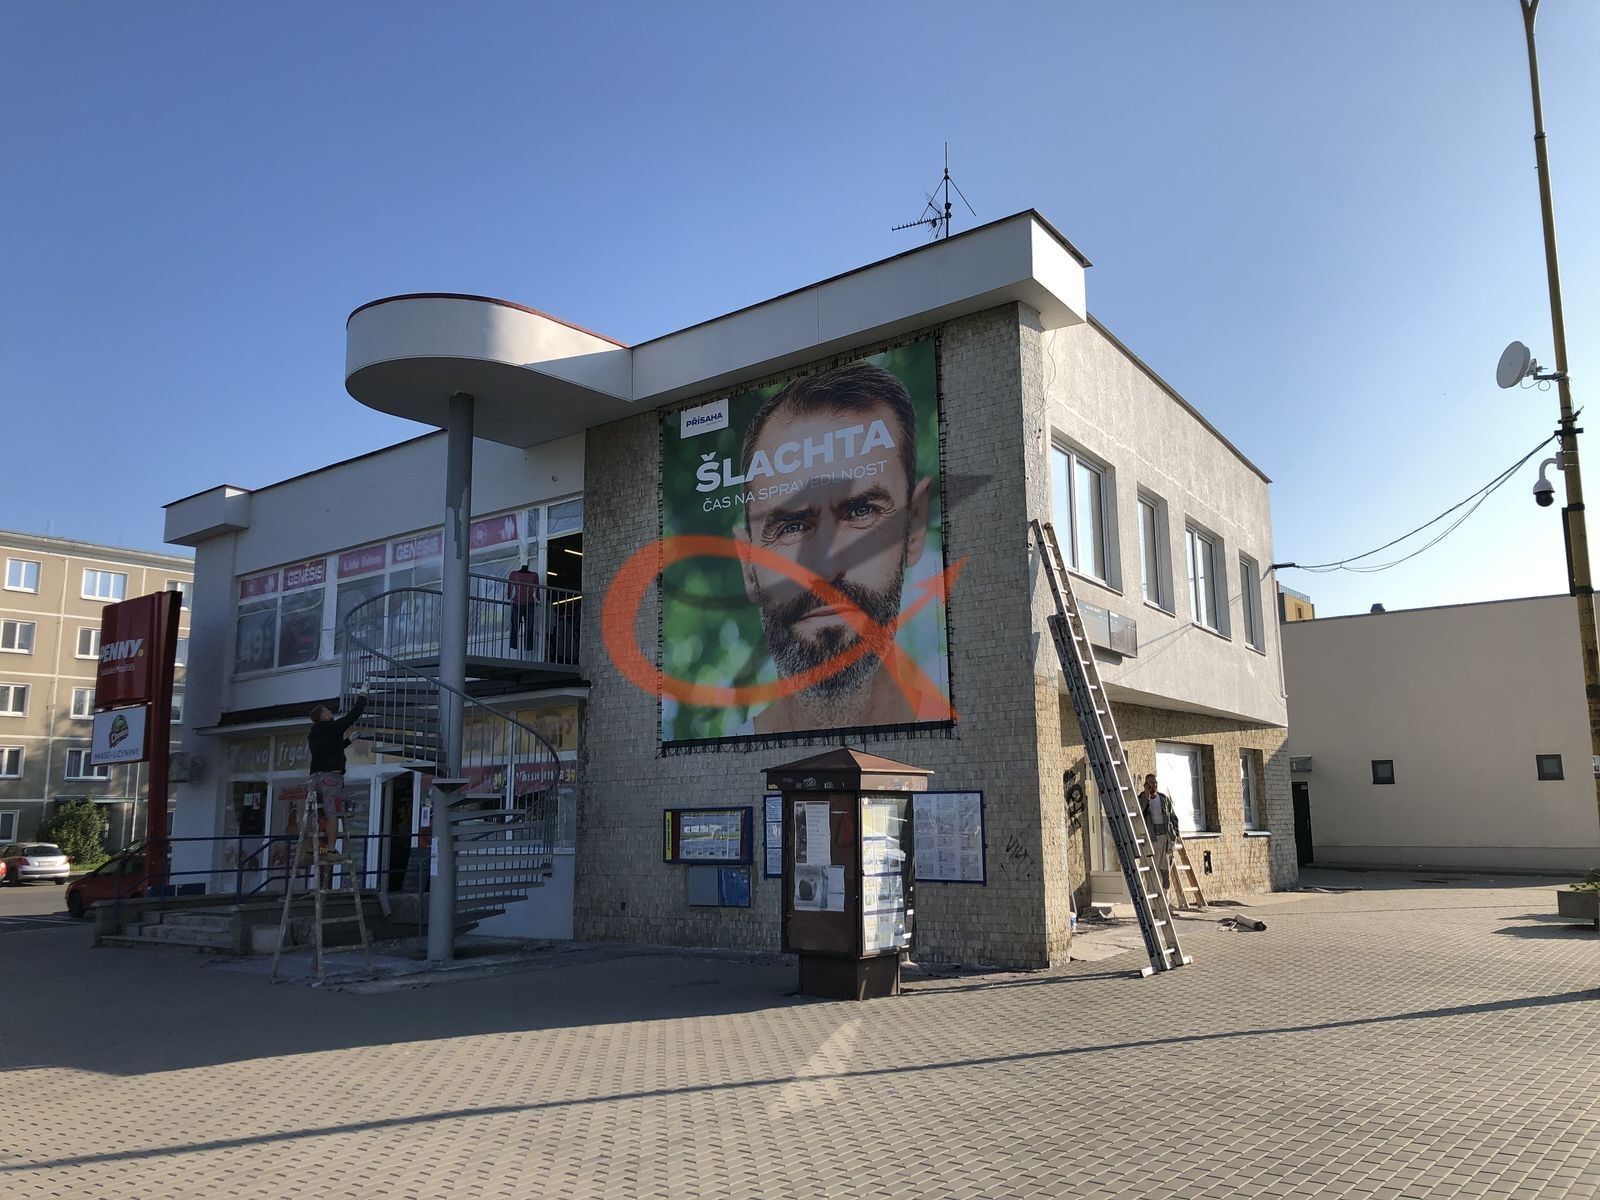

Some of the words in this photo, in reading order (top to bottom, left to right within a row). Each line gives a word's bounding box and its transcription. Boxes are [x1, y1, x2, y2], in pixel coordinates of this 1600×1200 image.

[686, 411, 724, 428] PŘÍSAHA
[696, 418, 896, 493] ŠLACHTA
[703, 496, 731, 512] ČAS
[734, 491, 756, 506] NA
[758, 460, 888, 500] SPRAVEDLNOST
[396, 537, 439, 561] GENESIS
[287, 564, 323, 587] GENESIS
